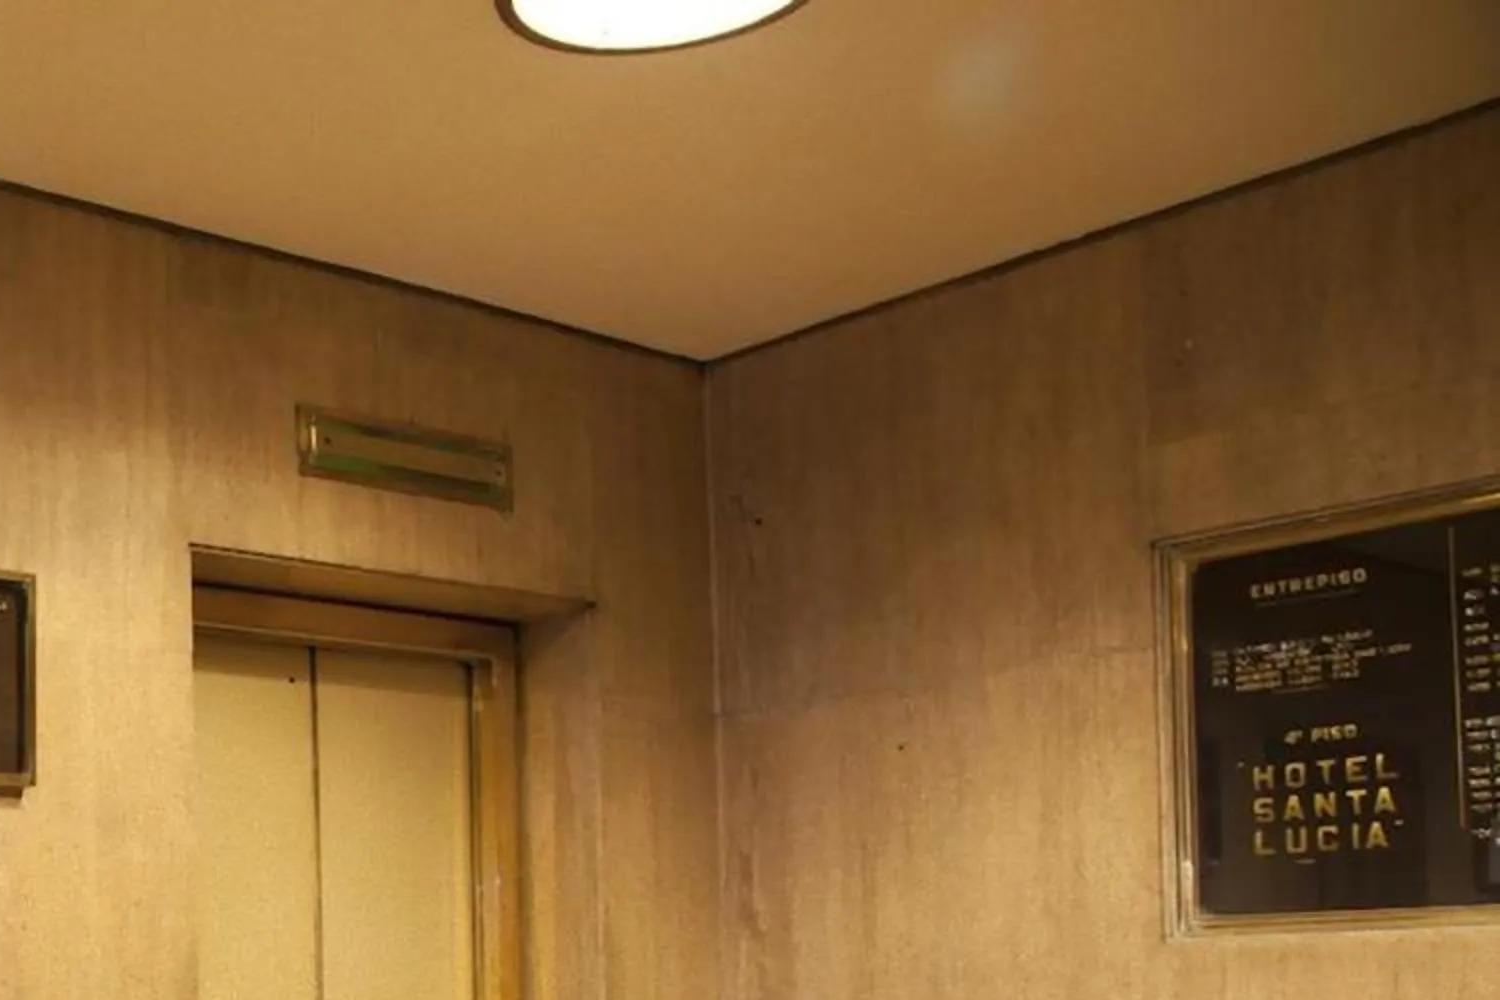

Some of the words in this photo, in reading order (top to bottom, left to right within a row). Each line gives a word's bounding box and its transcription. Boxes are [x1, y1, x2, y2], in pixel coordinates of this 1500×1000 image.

[1311, 723, 1358, 743] PISO
[1252, 752, 1399, 791] HOTEL
[1252, 786, 1396, 823] SANTA
[1253, 820, 1389, 855] LUCIA
